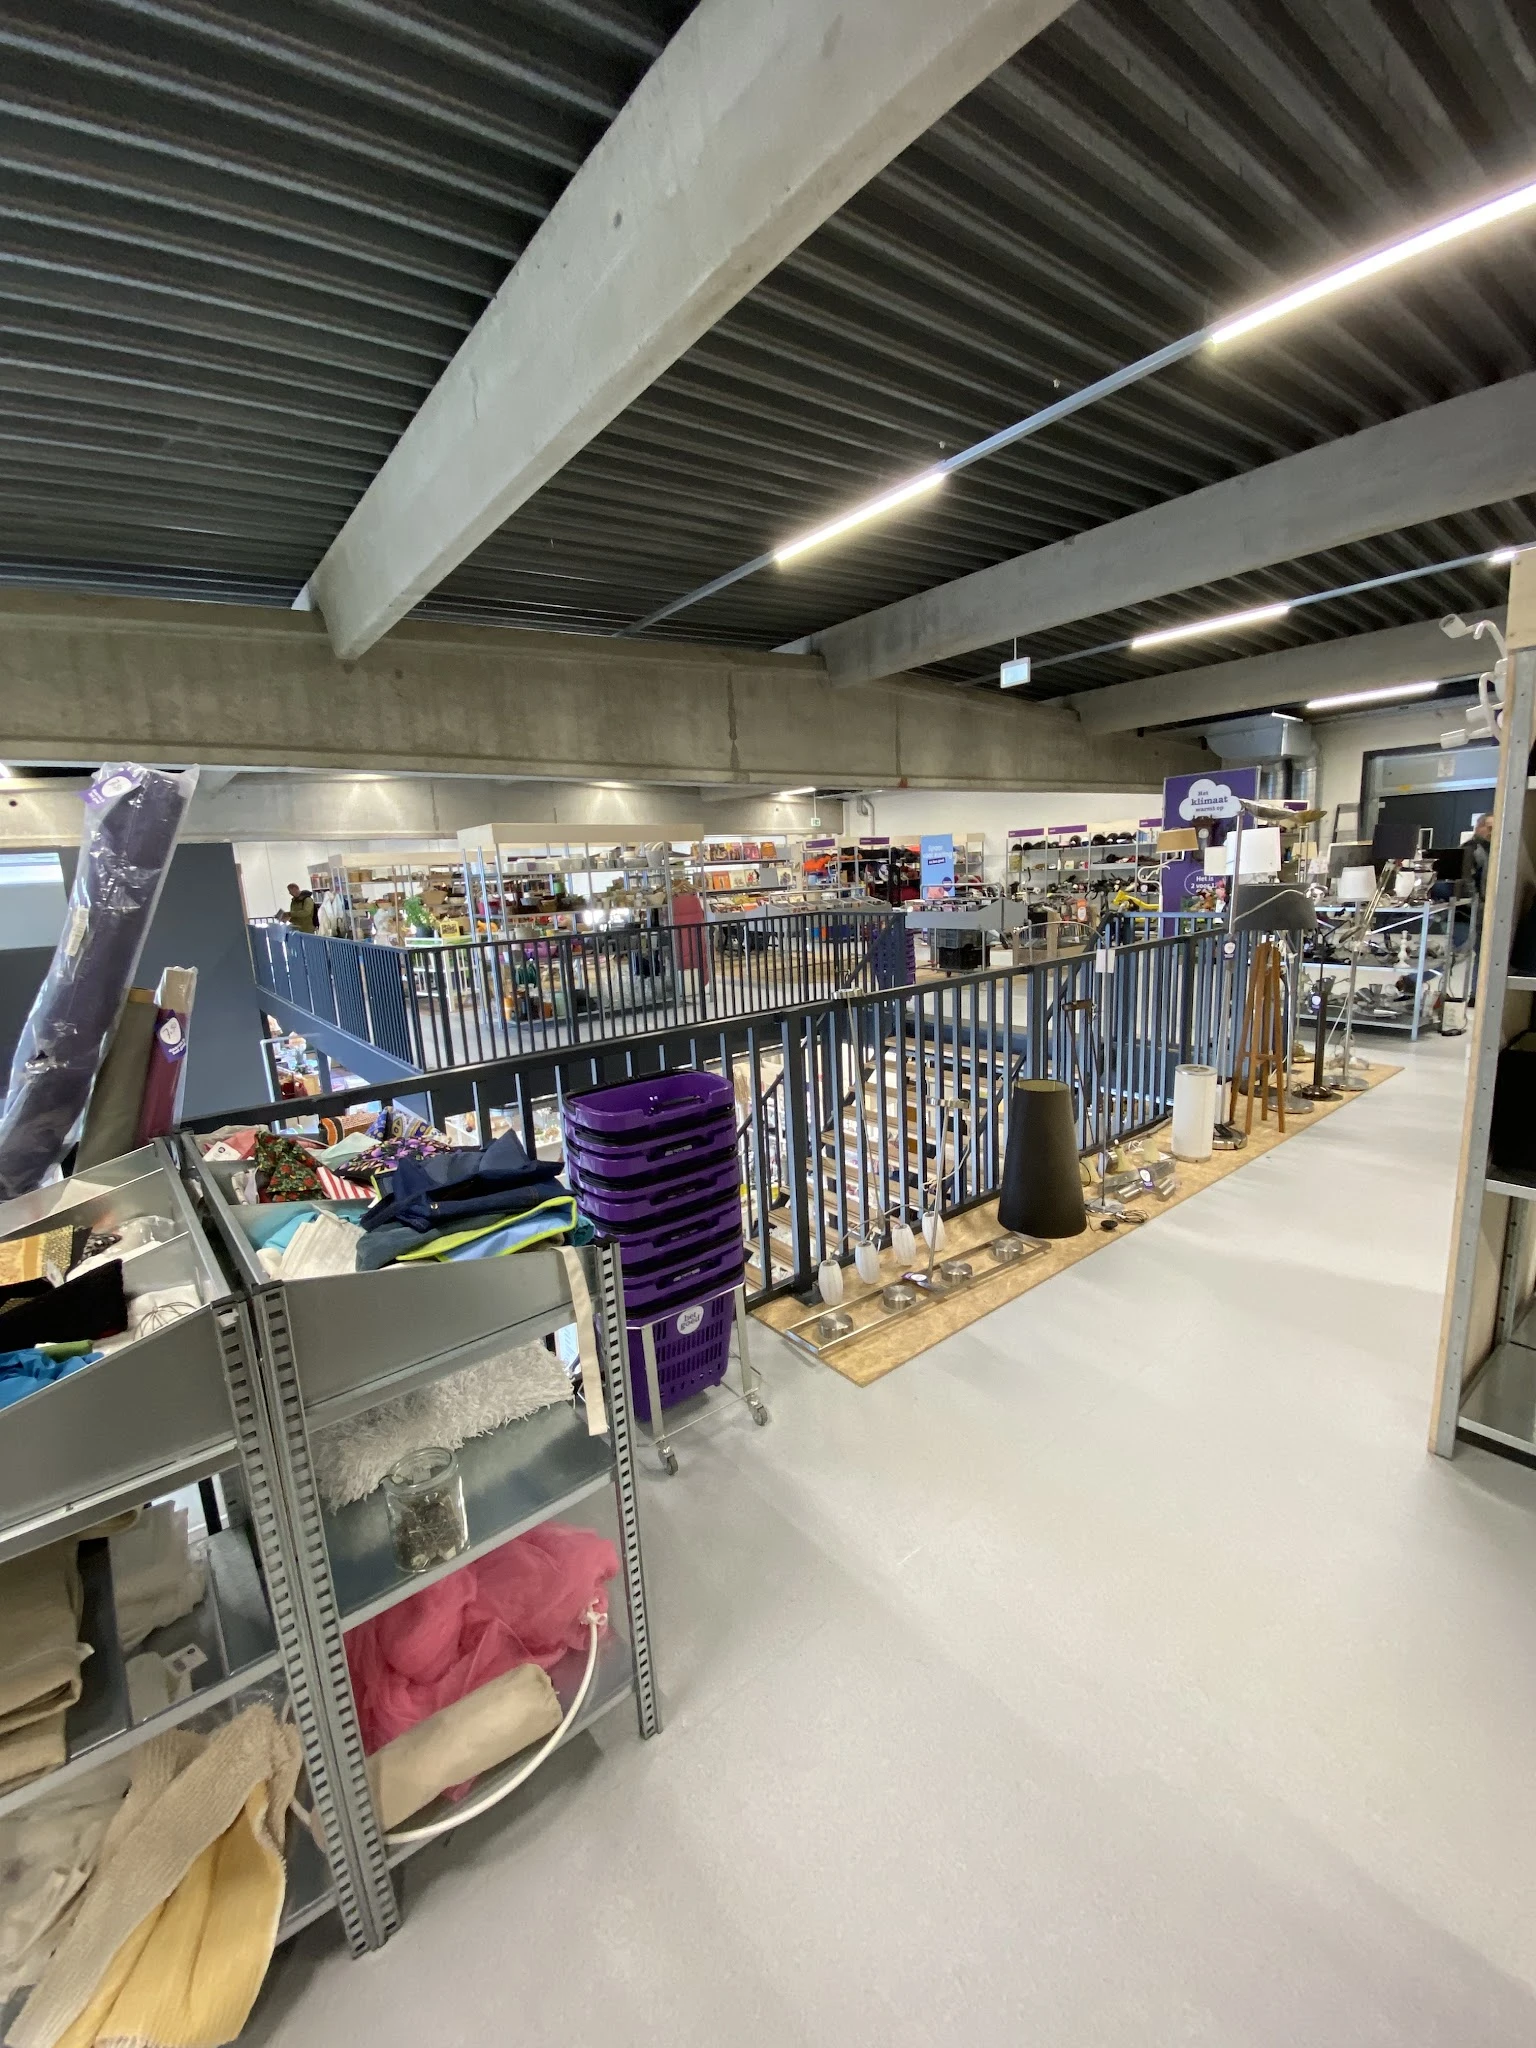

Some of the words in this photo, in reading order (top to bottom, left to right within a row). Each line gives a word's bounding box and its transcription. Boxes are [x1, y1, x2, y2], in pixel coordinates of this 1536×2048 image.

[1191, 796, 1228, 806] klimaat
[684, 1312, 696, 1322] het
[680, 1314, 700, 1331] goed
